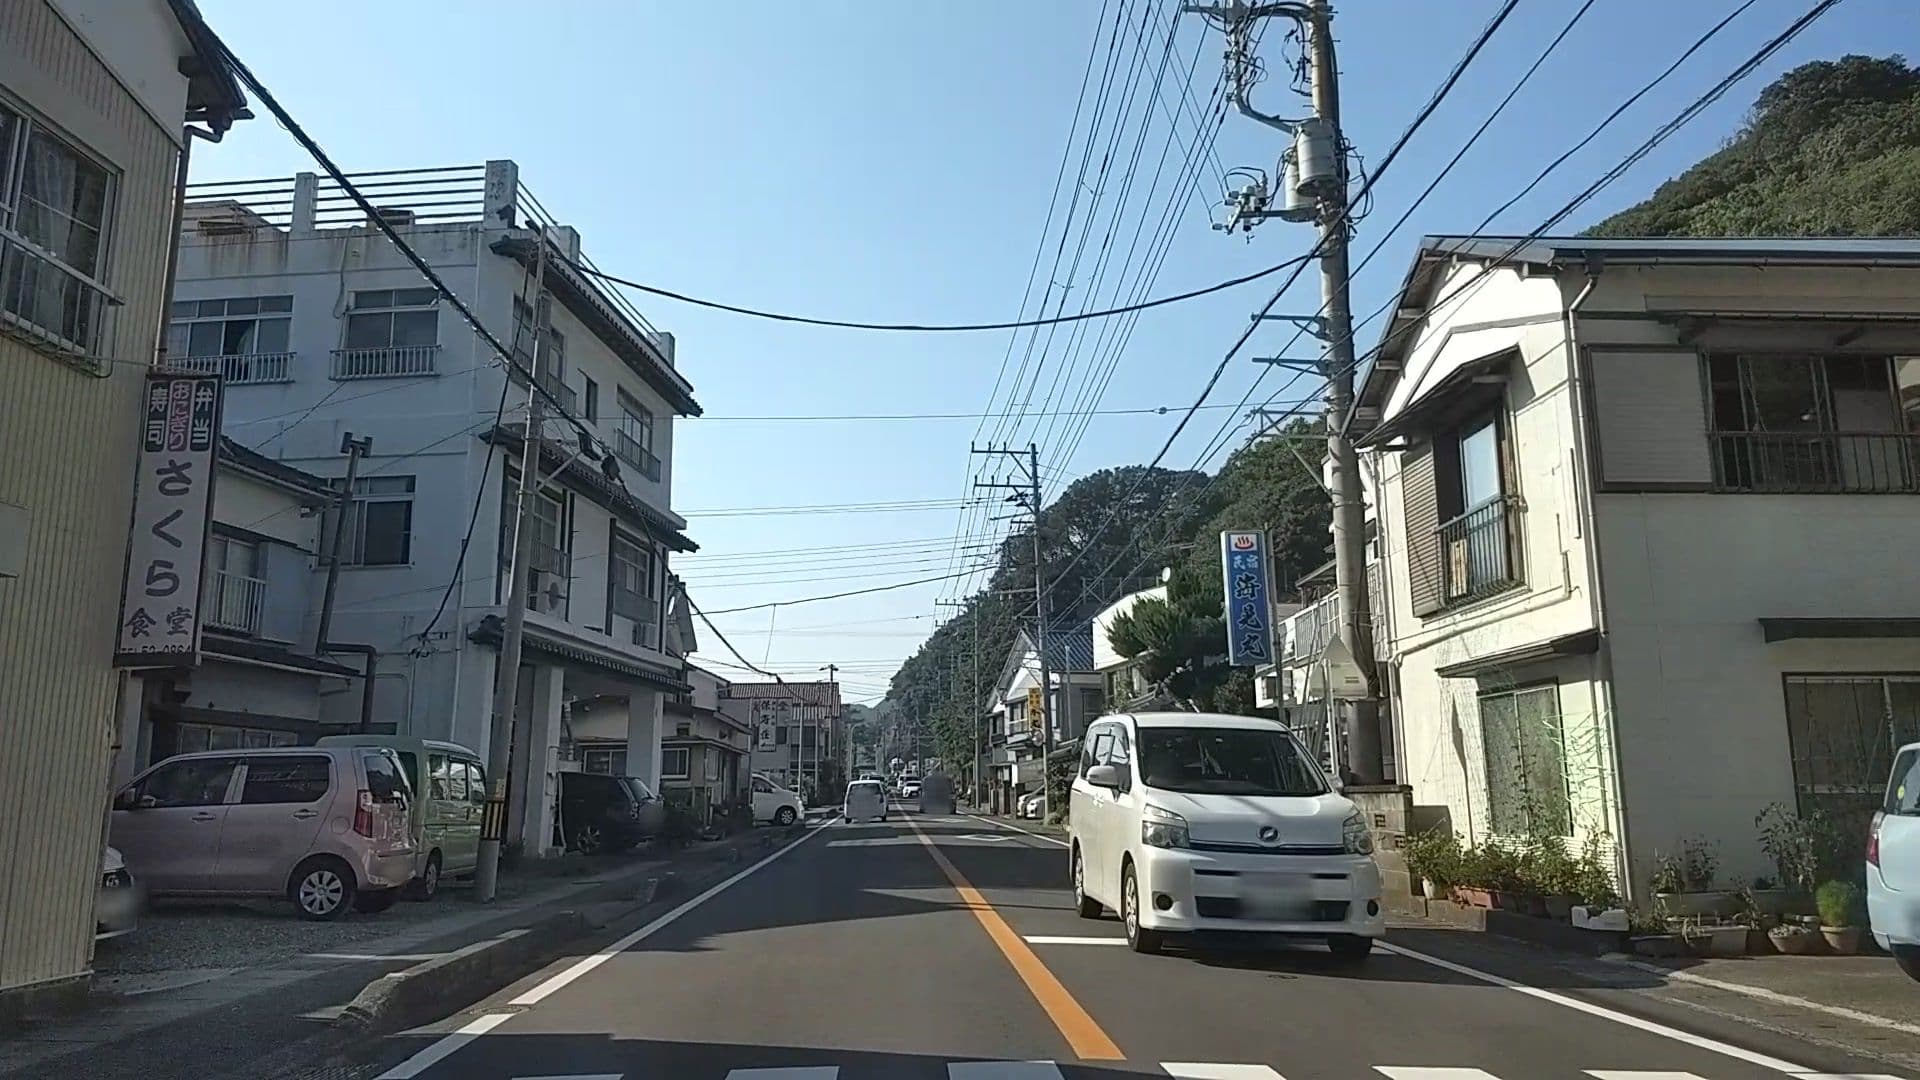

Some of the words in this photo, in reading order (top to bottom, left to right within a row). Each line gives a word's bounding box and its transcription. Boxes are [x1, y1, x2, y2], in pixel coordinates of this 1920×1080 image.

[148, 387, 168, 445] 寿司
[170, 383, 190, 450] おにぎり
[192, 386, 213, 443] 弁当
[146, 459, 192, 597] さくら
[1233, 555, 1259, 570] 民宿
[125, 606, 192, 638] 食堂
